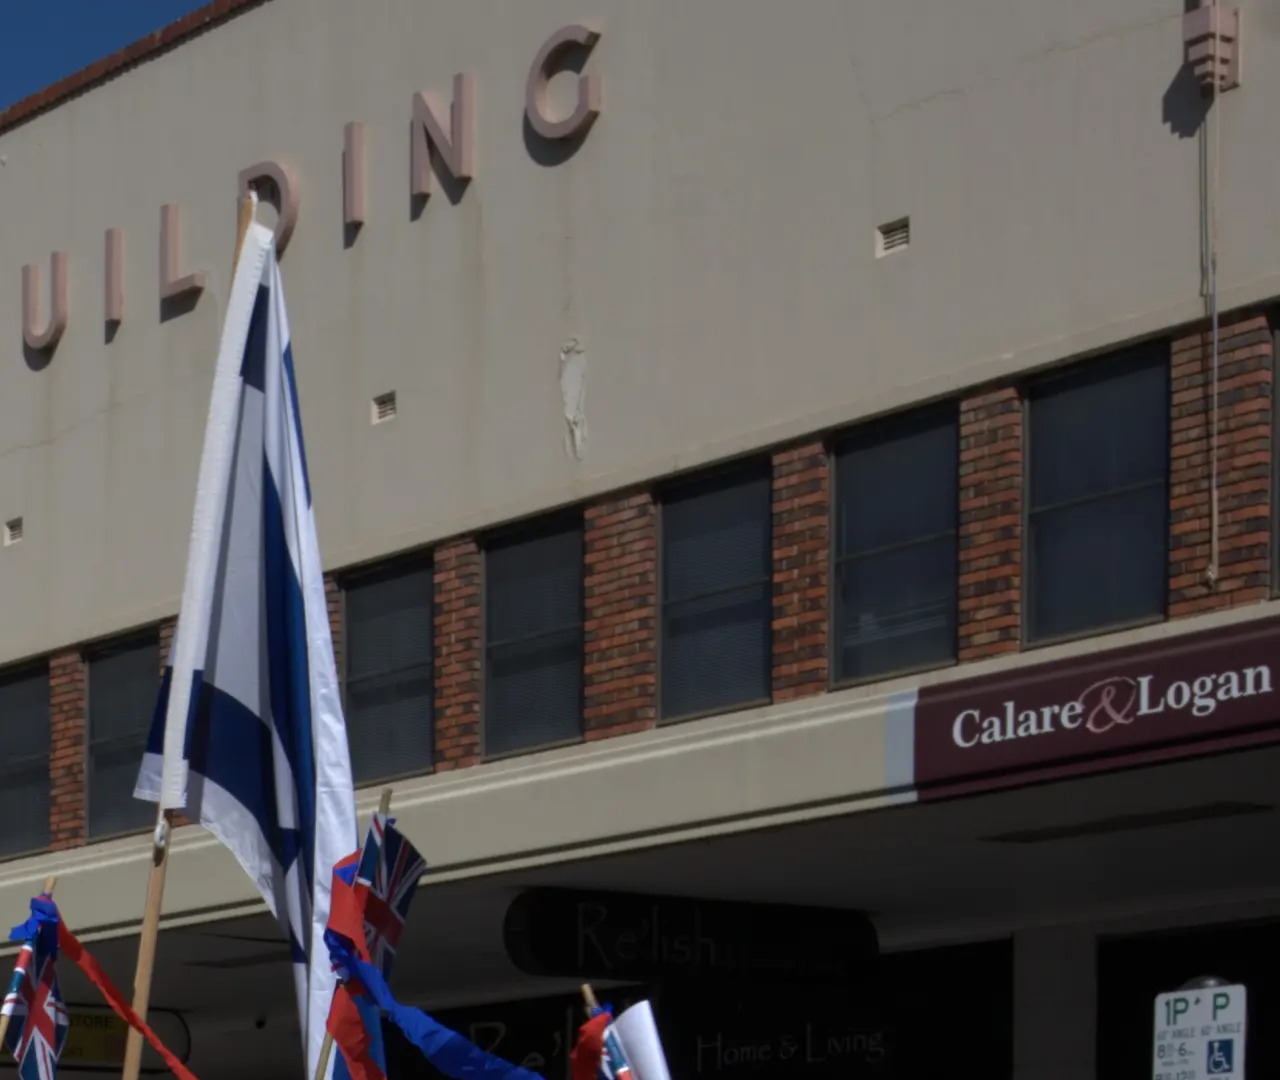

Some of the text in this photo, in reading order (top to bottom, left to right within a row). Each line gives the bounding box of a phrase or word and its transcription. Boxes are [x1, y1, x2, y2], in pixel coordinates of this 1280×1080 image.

[952, 701, 1082, 748] Calare
[1136, 665, 1273, 716] Logan
[1164, 992, 1231, 1027] 1P P
[696, 1030, 772, 1073] Home
[804, 1021, 885, 1064] Living
